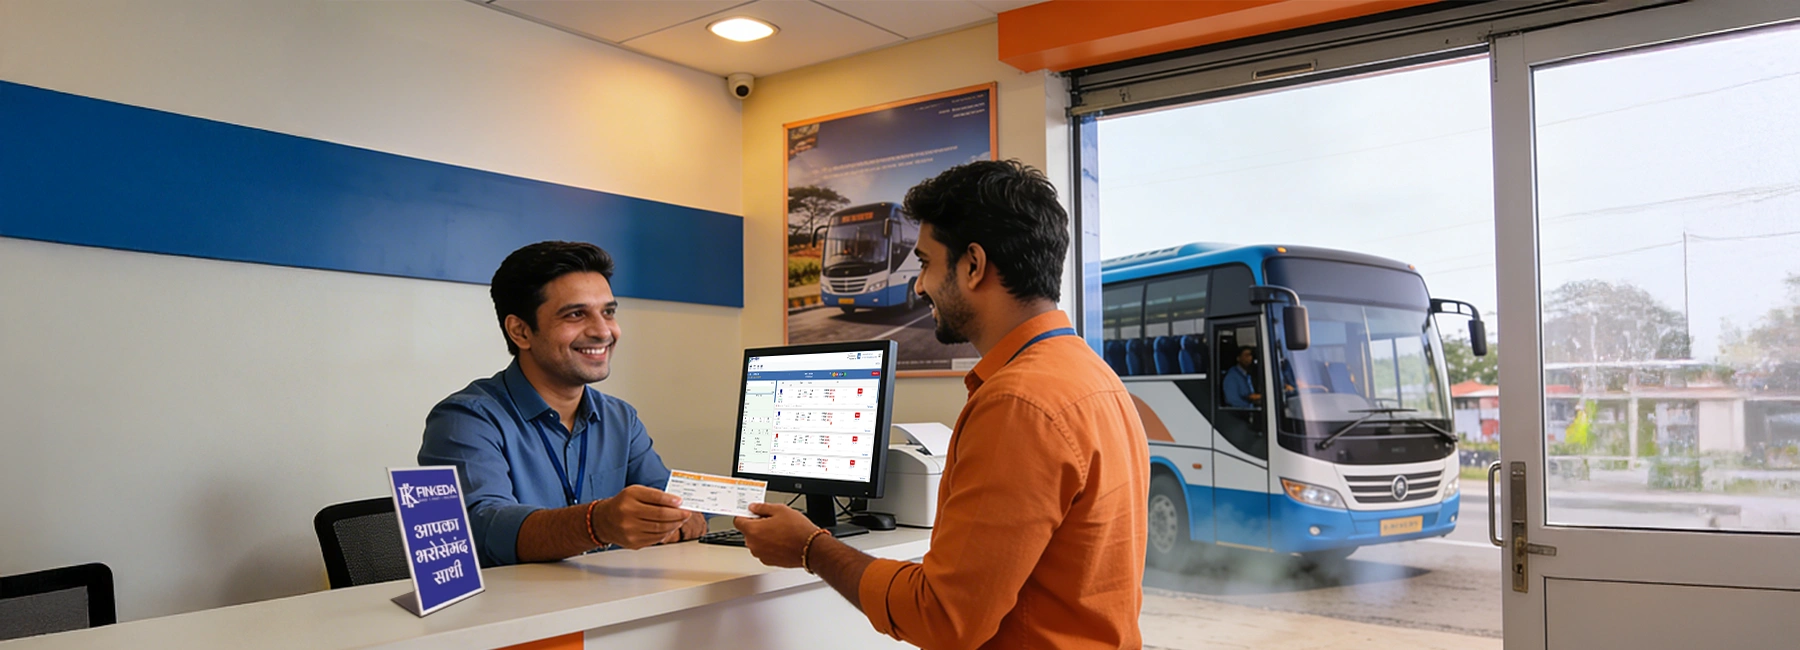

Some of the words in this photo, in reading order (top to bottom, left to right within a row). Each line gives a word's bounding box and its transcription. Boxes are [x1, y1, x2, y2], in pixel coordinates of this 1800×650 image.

[416, 484, 457, 497] FINKEDA
[414, 518, 459, 538] आपका
[416, 537, 468, 563] भरोसेमंद
[433, 559, 463, 584] साथी
